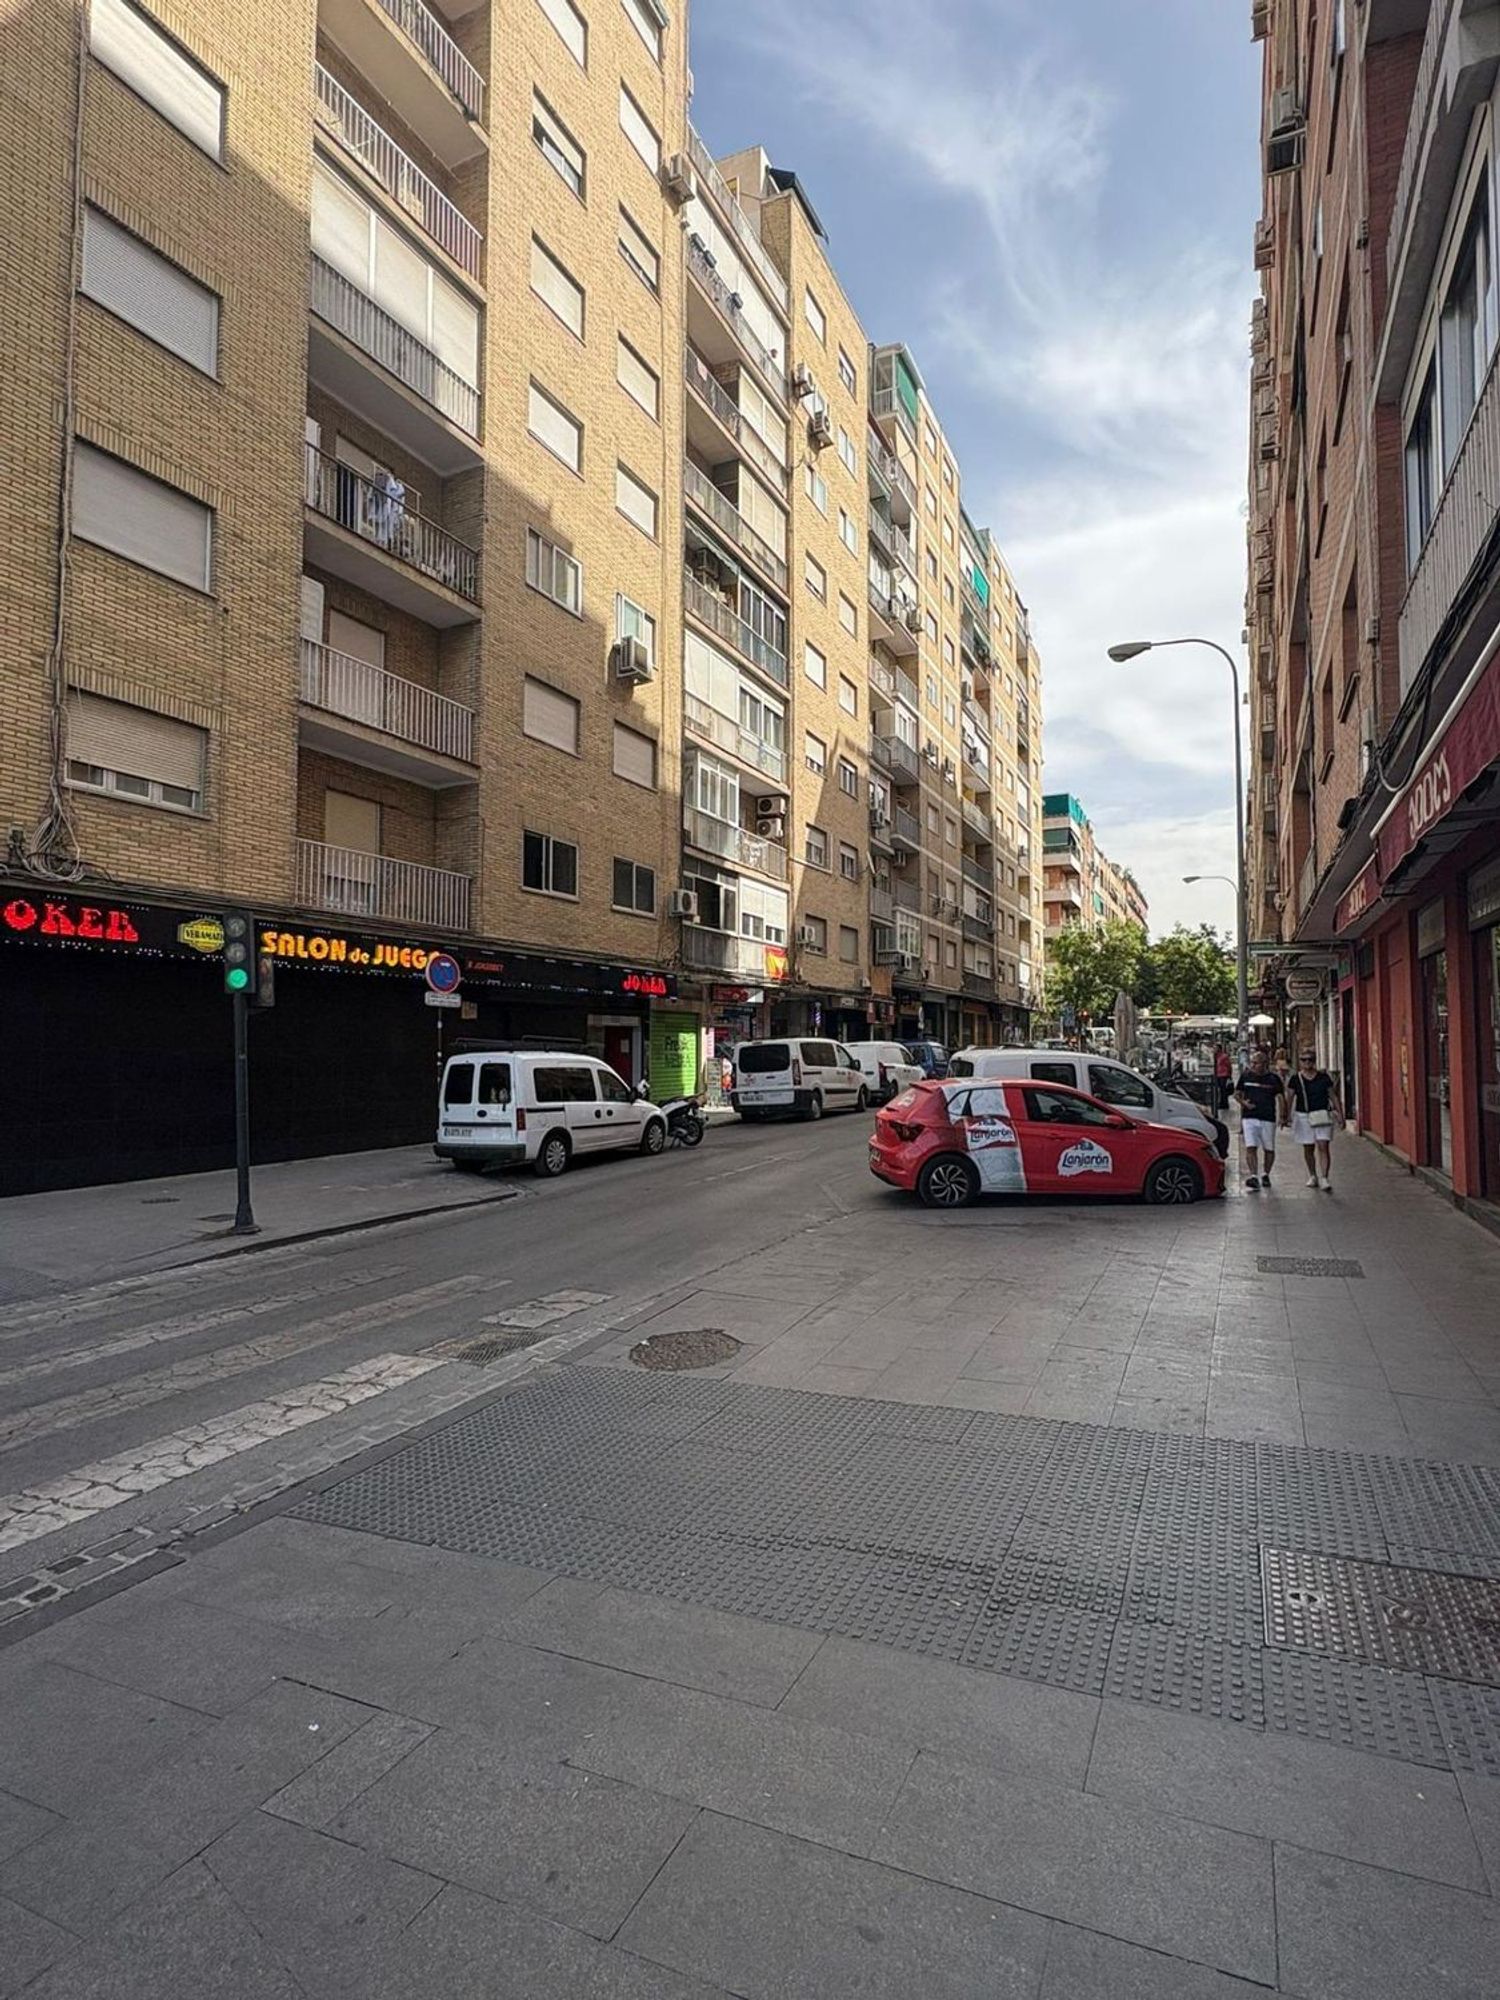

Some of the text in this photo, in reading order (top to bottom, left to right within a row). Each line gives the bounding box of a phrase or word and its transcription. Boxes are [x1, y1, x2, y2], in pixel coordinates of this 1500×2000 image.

[260, 931, 348, 962] SALON
[349, 948, 371, 964] de
[624, 975, 666, 994] JOKER
[1062, 1152, 1109, 1168] Lanjarón
